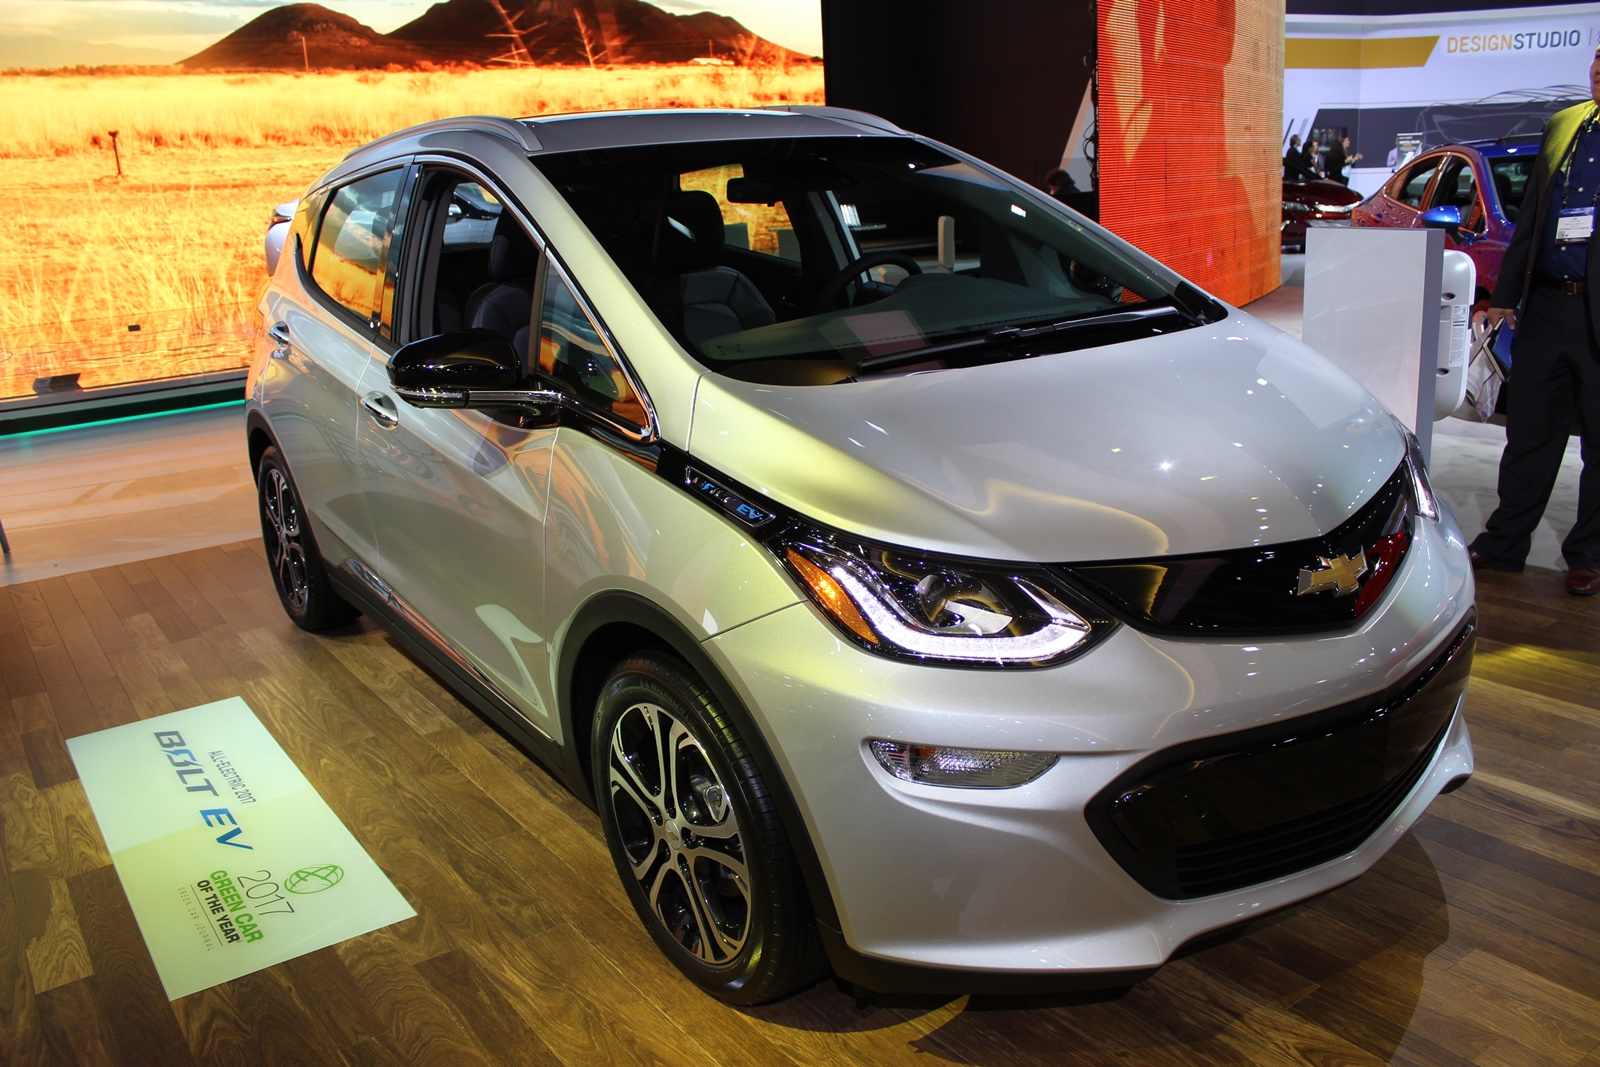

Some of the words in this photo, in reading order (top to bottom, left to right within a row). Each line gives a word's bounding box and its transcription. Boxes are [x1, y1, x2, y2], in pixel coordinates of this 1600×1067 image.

[1447, 30, 1581, 53] DESIGNSTUDIO
[153, 730, 220, 797] BOLT
[199, 808, 254, 850] EV
[208, 750, 246, 790] ALL-ELECTRIC
[234, 788, 257, 804] 2017
[197, 880, 214, 893] OF
[205, 894, 225, 915] THE
[210, 870, 247, 913] GREEN
[234, 913, 264, 944] CAR
[237, 869, 295, 916] 2017
[177, 886, 192, 906] GREEN
[188, 907, 200, 920] CAR
[195, 922, 215, 952] JOURNAL
